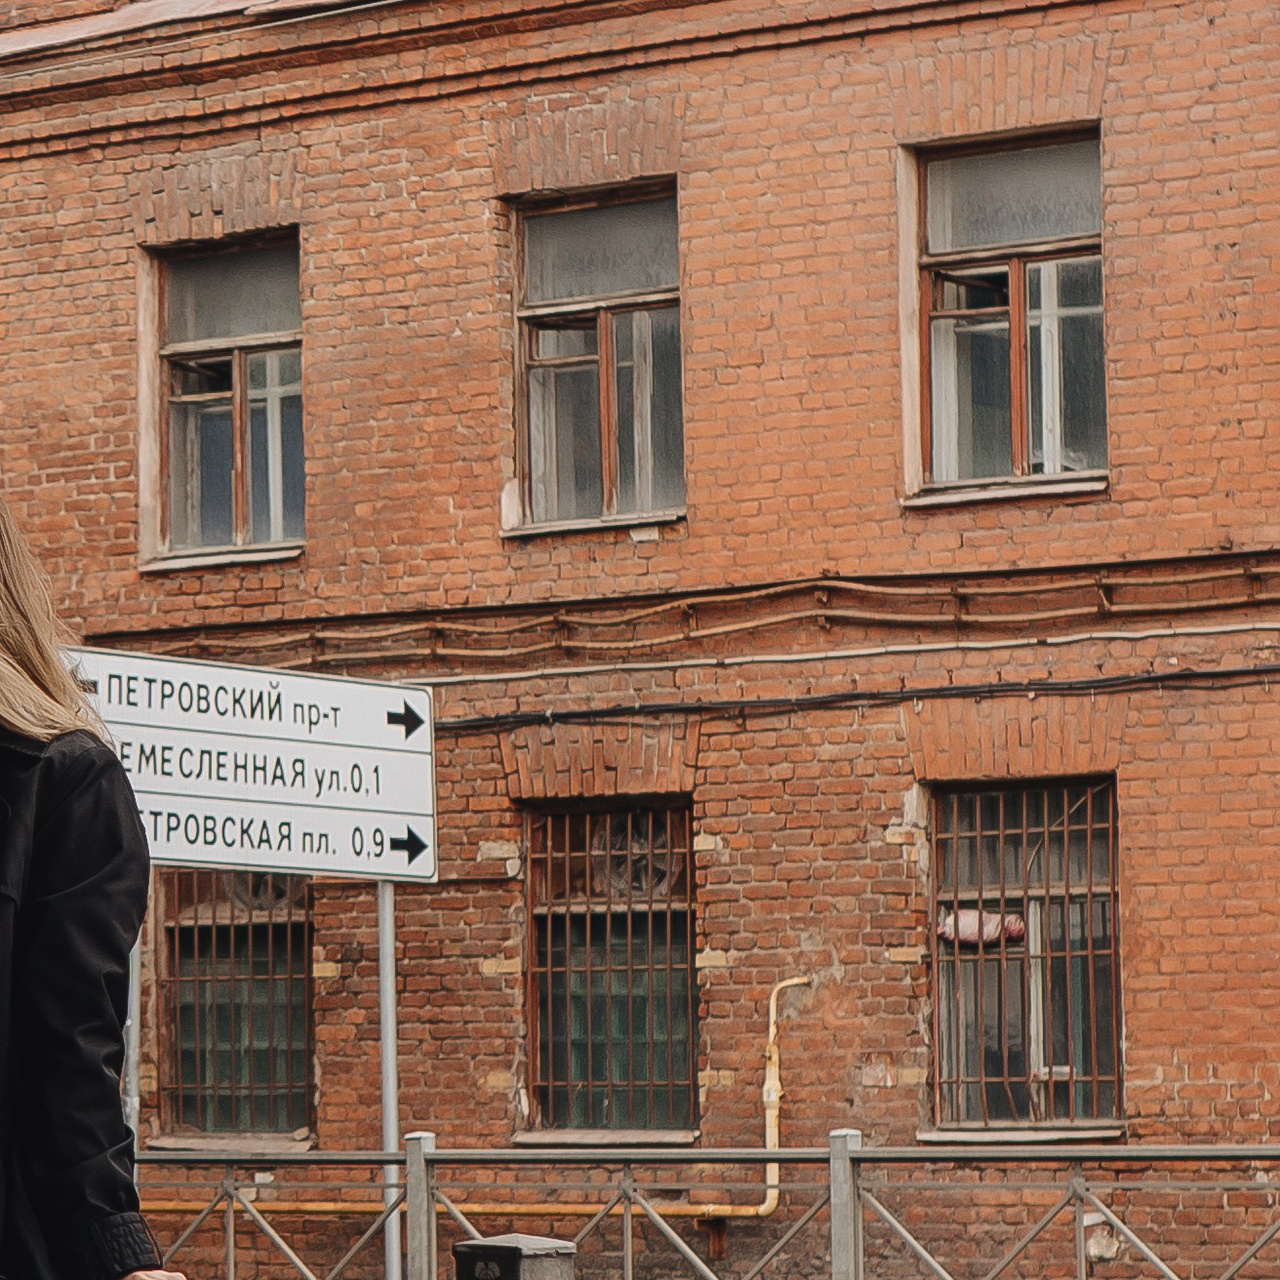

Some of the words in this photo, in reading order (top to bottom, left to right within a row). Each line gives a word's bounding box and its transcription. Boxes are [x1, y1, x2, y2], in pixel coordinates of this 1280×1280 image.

[108, 674, 283, 722] ПЕТРОВСКИЙ
[293, 703, 342, 734] пр-т
[120, 741, 306, 788] ЕМЕСЛЕННАЯ
[138, 809, 292, 851] ТРОВСКАЯ
[302, 831, 337, 855] пл.
[351, 826, 385, 860] 0,9
